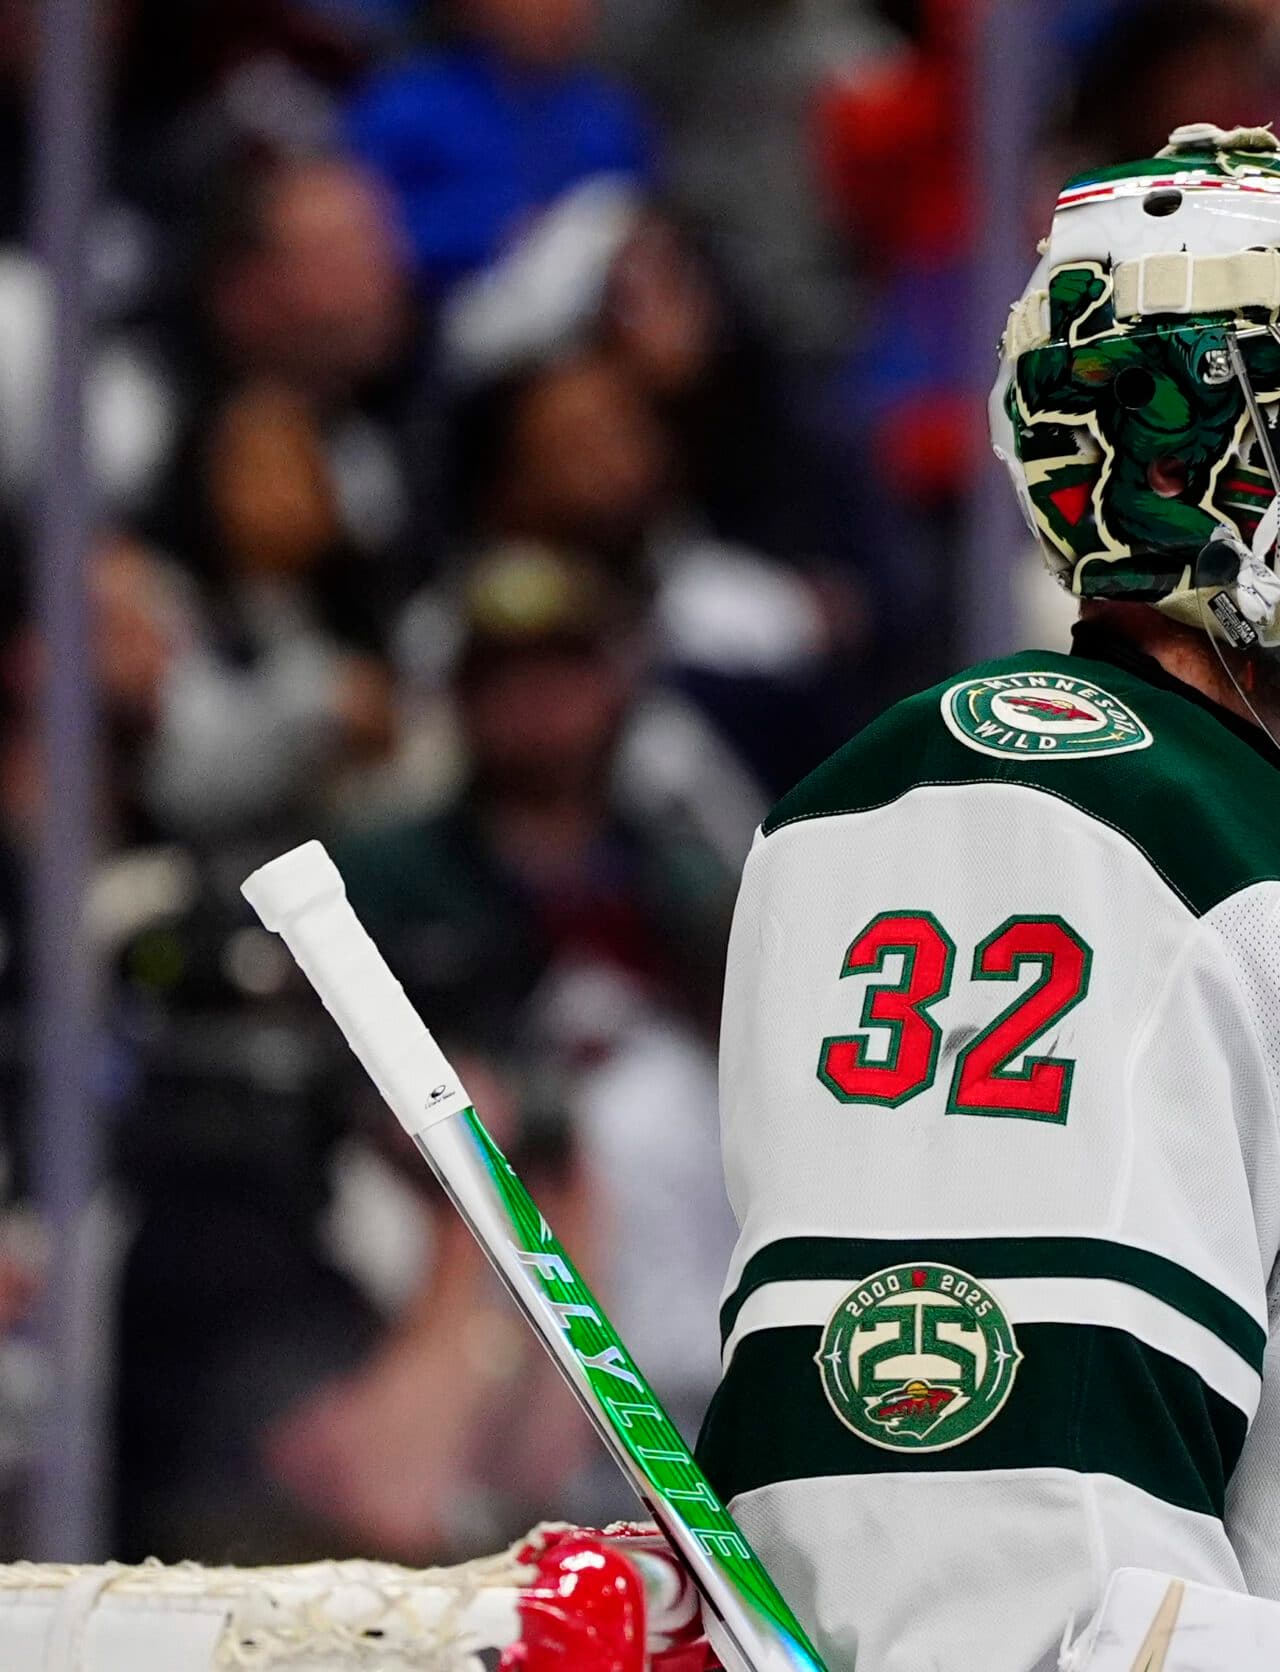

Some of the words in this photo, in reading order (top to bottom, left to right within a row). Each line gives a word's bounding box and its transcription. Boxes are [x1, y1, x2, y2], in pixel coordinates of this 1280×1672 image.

[973, 719, 1058, 750] WILD
[816, 909, 1094, 1126] 32
[845, 1274, 901, 1317] 2000
[939, 1273, 994, 1317] 2025
[858, 1303, 978, 1397] 25
[507, 1240, 751, 1560] FLYLITE
